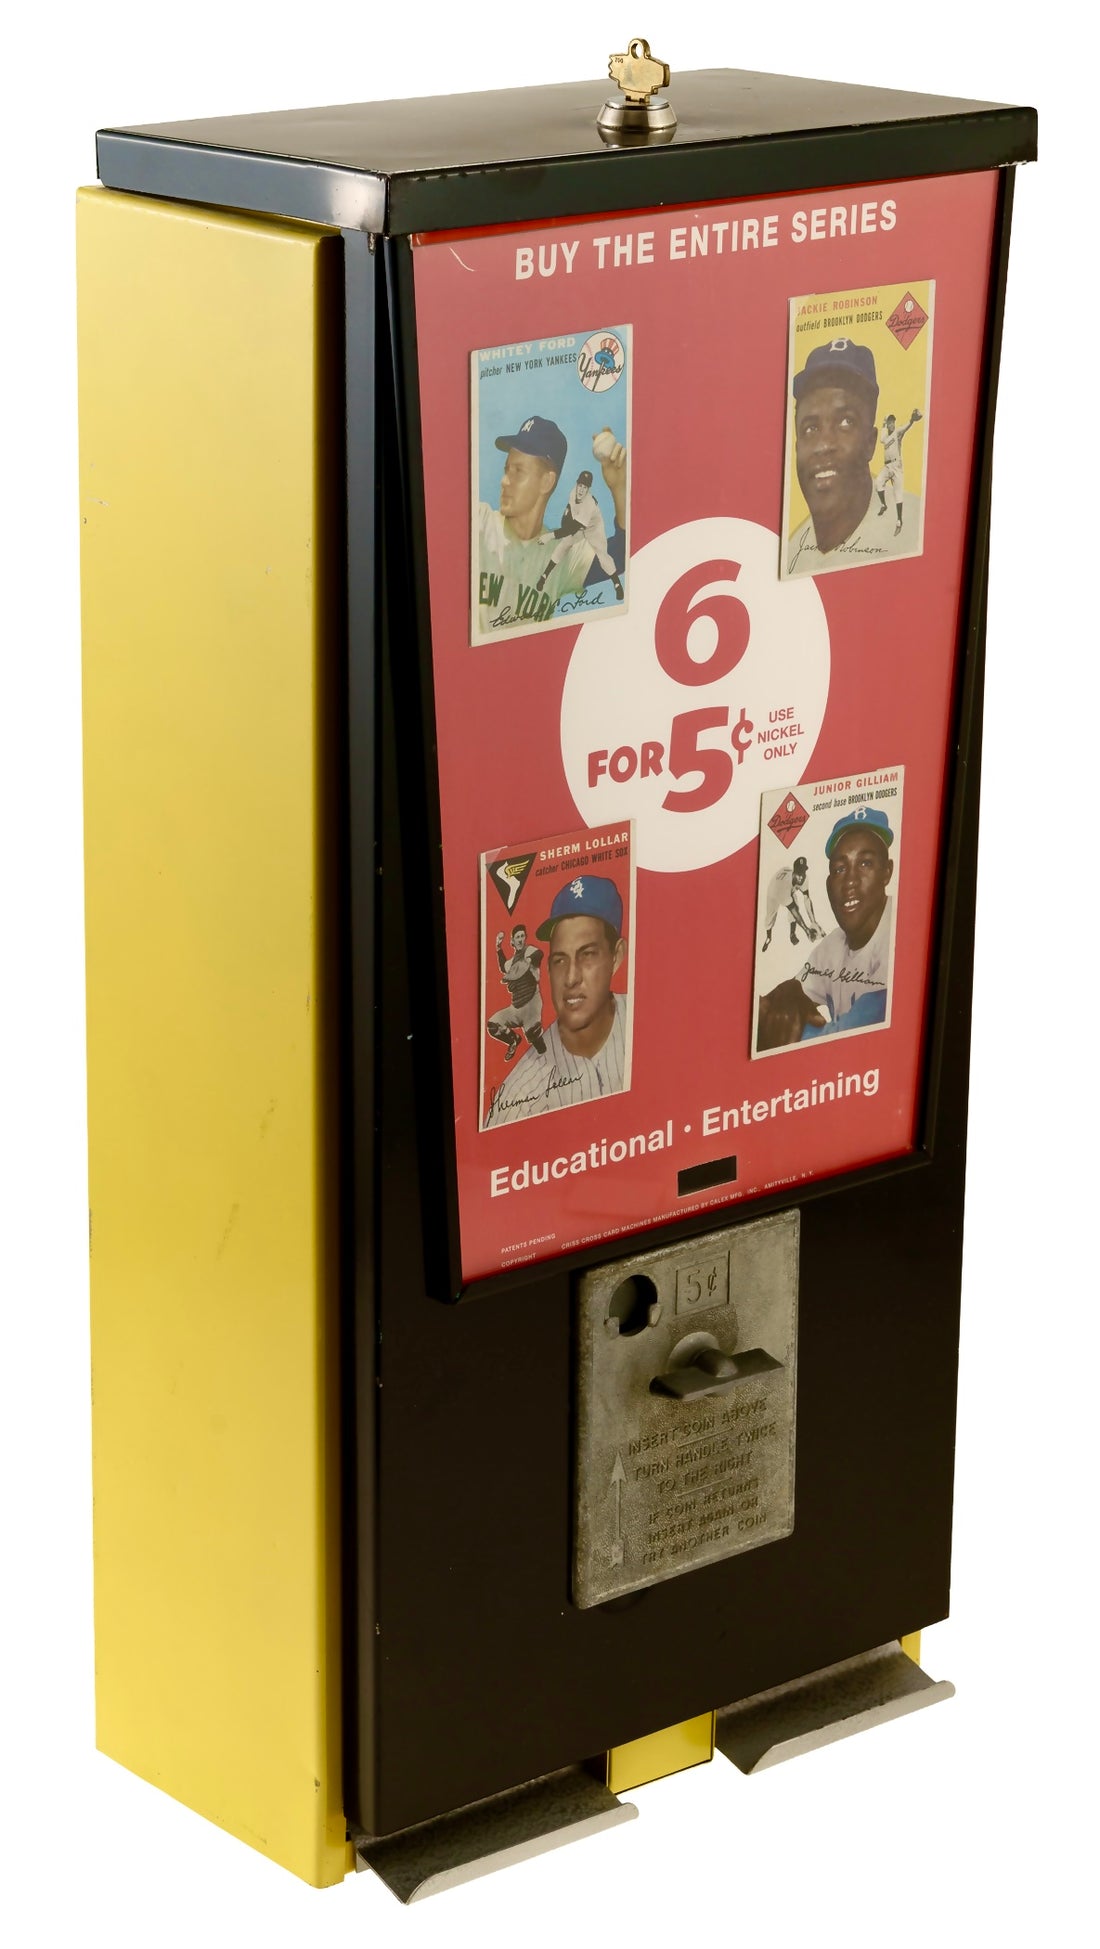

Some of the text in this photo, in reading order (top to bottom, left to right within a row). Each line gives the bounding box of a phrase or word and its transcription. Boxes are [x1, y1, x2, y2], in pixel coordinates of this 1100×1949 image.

[515, 199, 897, 280] BUY THE ENTIRE SERIES
[797, 296, 878, 317] JACKIE ROBINSON
[796, 311, 883, 332] outfield BROOKLYN DODGERS
[479, 336, 576, 361] WHITEY FORD
[480, 352, 577, 380] pitcher NEW YORK YANKEES
[577, 352, 624, 392] Yankees
[655, 559, 750, 687] 6
[768, 707, 795, 723] USE
[757, 723, 804, 744] NICKEL
[587, 741, 665, 788] FOR
[763, 742, 798, 761] ONLY
[813, 772, 898, 796] JUNIOR GILLIAM
[812, 787, 898, 812] second base BROOKLYN DODGERS
[540, 832, 629, 861] SHERM LOLLAR
[535, 863, 559, 877] catcher
[561, 855, 589, 871] CHICAGO
[591, 850, 612, 864] WHITE
[615, 847, 628, 858] SOX
[490, 1067, 880, 1198] Educational Entertaining
[561, 1239, 580, 1250] CRISS
[581, 1234, 601, 1244] CROSS
[603, 1227, 620, 1238] CARD
[621, 1218, 651, 1233] MACHINES
[653, 1204, 700, 1223] MANUFACTURED
[709, 1195, 729, 1206] CALEX
[500, 1233, 556, 1255] PATENTS PENDING
[501, 1252, 537, 1268] COPYRIGHT
[686, 1266, 717, 1304] 5¢
[628, 1397, 767, 1456] INSERT COIN ABOVE
[634, 1421, 777, 1481] TURN HANDLE TWICE
[657, 1451, 753, 1494] TO THE RIGHT
[648, 1510, 660, 1525] IF
[666, 1499, 696, 1519] COIN
[741, 1496, 758, 1511] OR
[671, 1525, 730, 1556] ANOTHER
[737, 1512, 767, 1532] COIN
